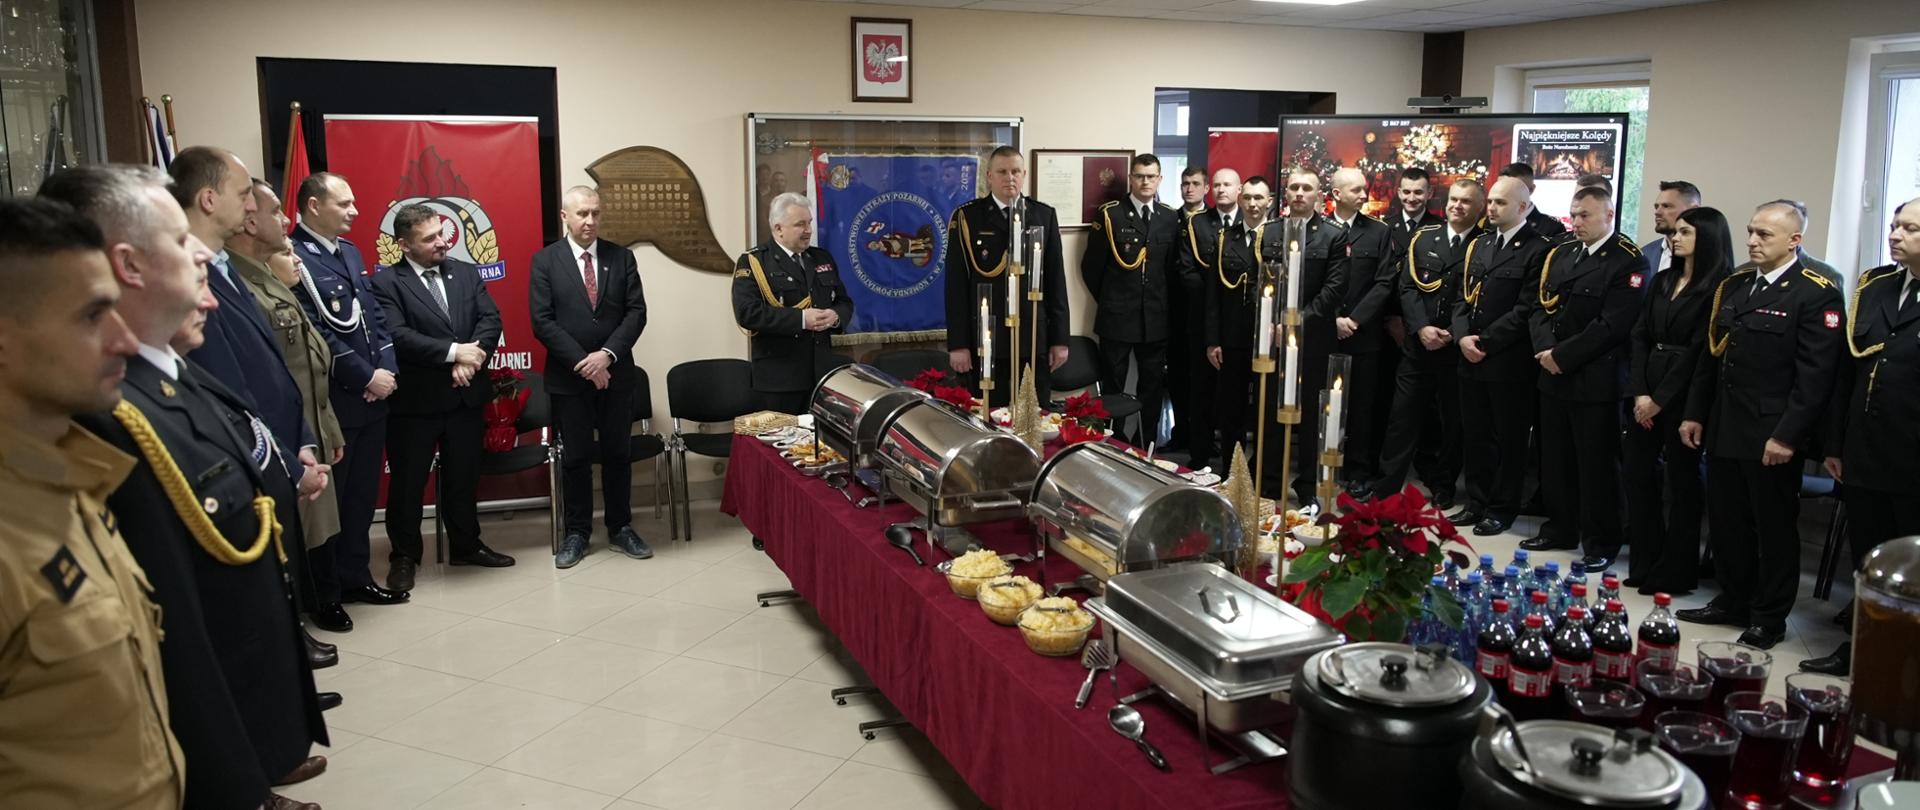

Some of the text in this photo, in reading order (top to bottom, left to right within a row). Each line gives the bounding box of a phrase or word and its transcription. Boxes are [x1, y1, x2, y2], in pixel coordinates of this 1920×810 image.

[1521, 131, 1612, 142] Najpiękniejsze Kolędy
[854, 263, 892, 296] POWIATOWA
[893, 279, 929, 297] KOMENDA
